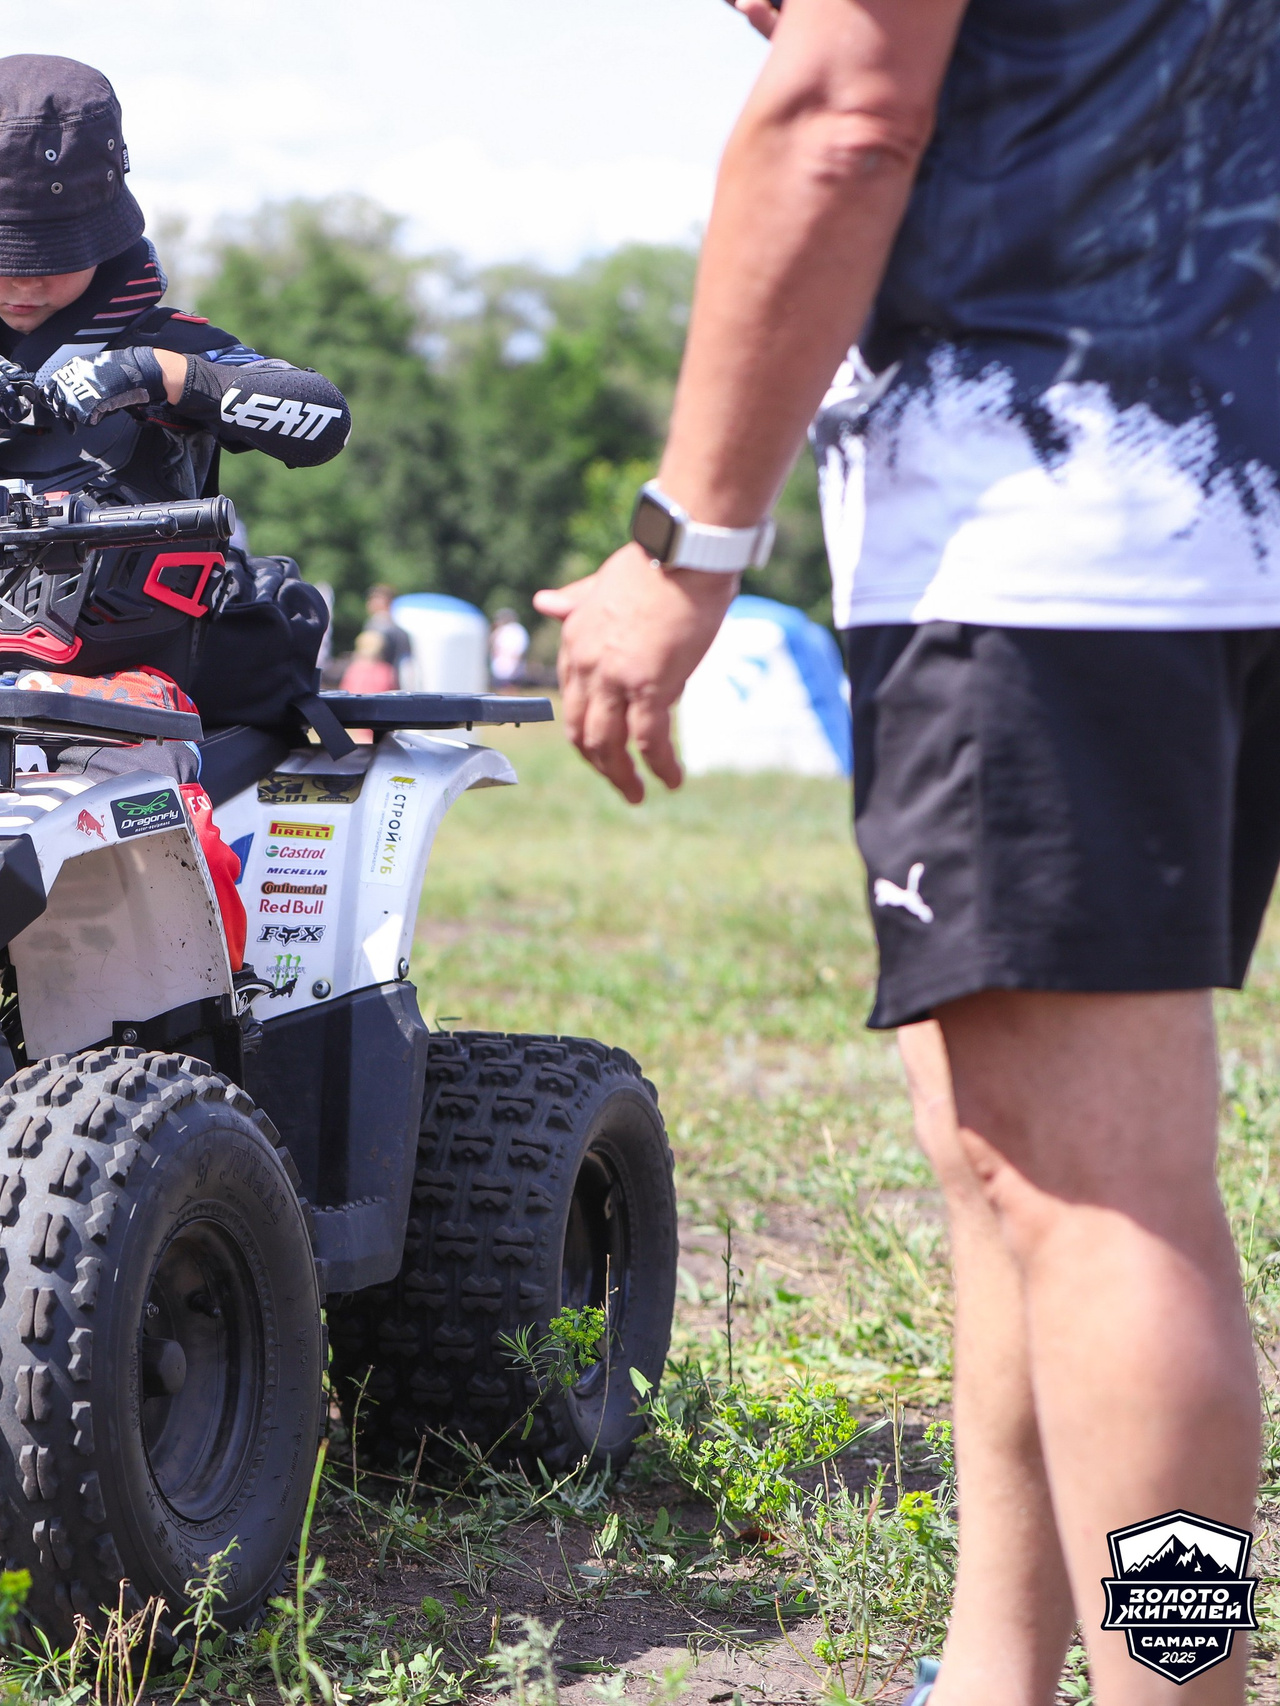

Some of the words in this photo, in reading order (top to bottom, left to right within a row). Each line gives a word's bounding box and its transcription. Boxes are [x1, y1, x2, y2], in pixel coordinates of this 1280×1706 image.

[221, 387, 343, 441] LEATT
[270, 822, 330, 838] PIRELLI
[279, 846, 326, 860] Castrol
[266, 867, 328, 876] MICHELIN
[261, 881, 328, 896] Continental
[259, 899, 291, 914] Red
[293, 900, 324, 915] Bull
